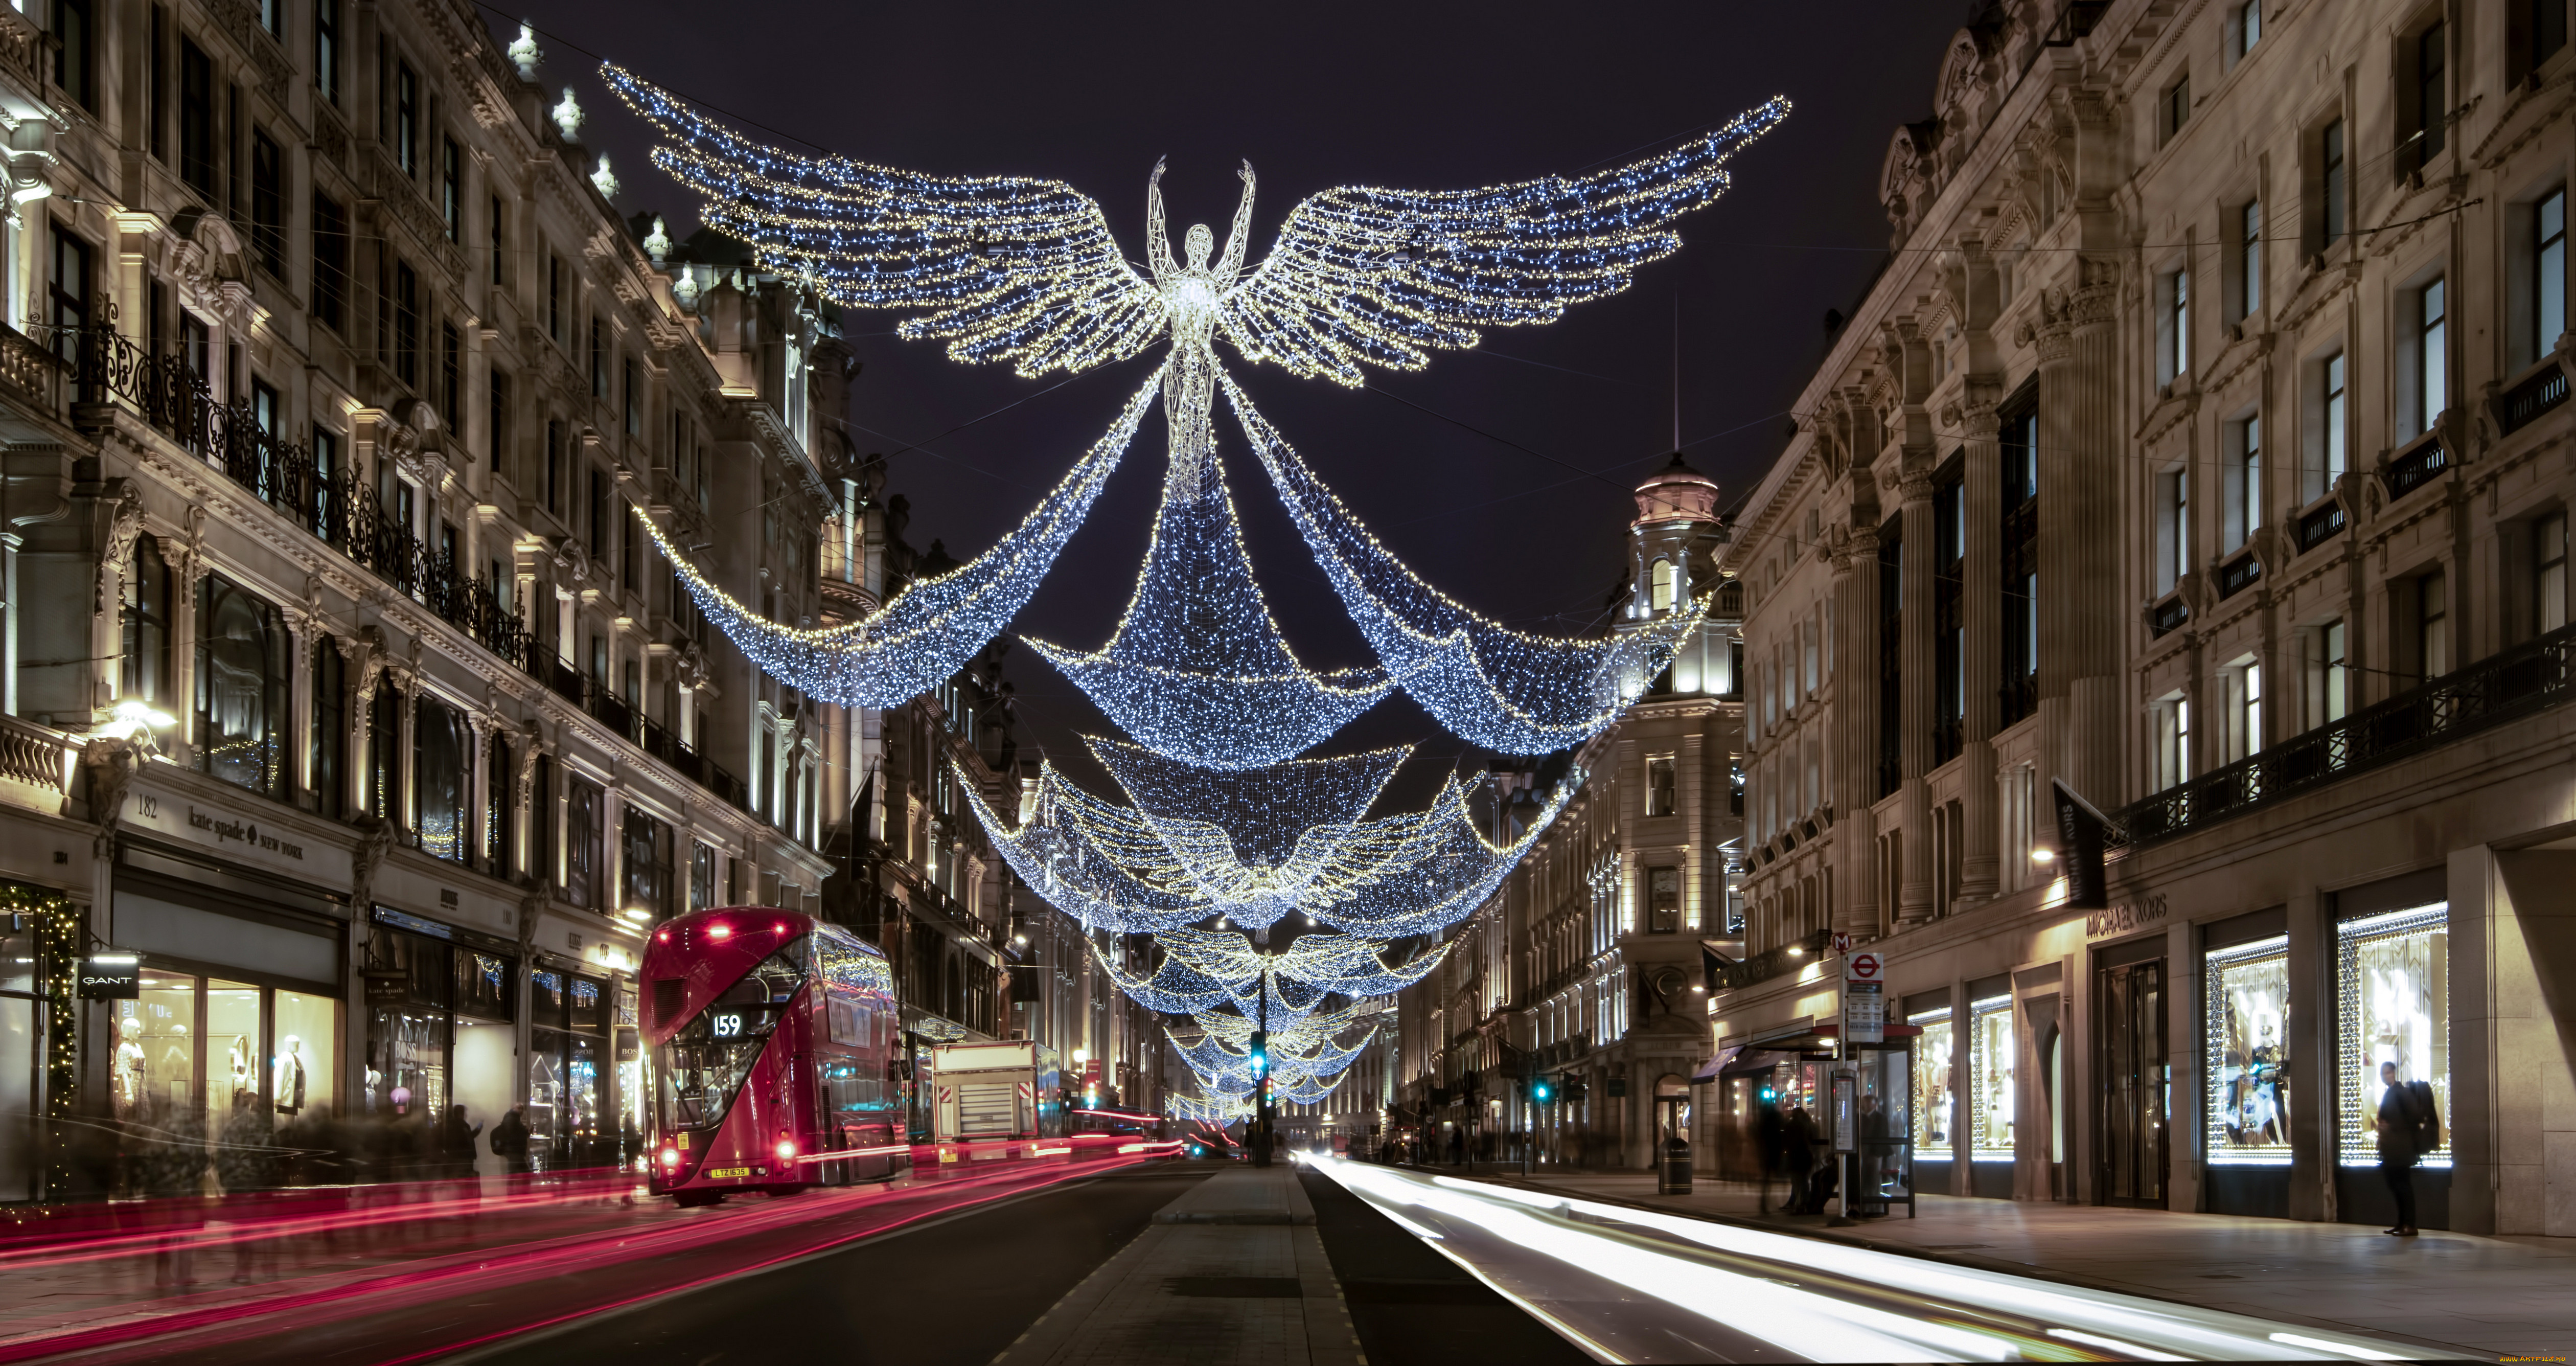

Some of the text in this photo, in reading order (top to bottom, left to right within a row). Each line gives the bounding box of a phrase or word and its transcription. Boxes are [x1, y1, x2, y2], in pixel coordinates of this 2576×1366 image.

[139, 794, 157, 818] 182
[188, 806, 303, 859] kate spade NEW YORK
[2063, 805, 2075, 839] KORS
[503, 909, 512, 925] 180
[2136, 893, 2167, 923] KORS
[385, 987, 405, 995] spade
[714, 1014, 741, 1035] 159
[396, 1041, 416, 1060] BOSS
